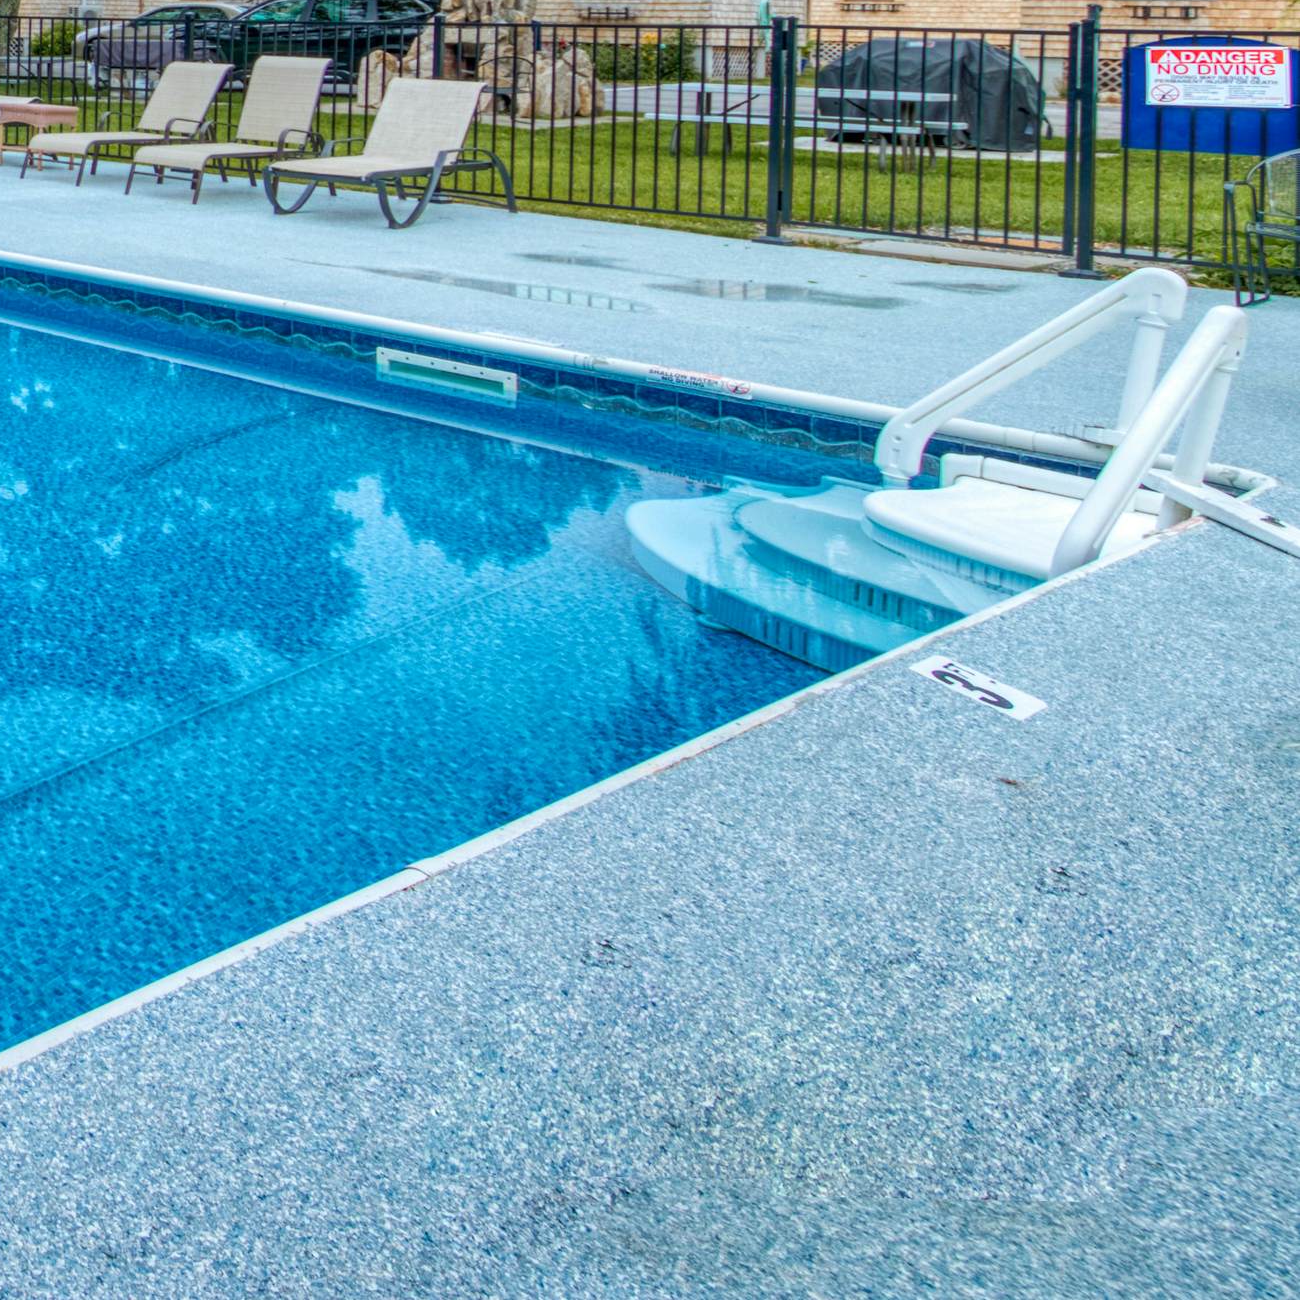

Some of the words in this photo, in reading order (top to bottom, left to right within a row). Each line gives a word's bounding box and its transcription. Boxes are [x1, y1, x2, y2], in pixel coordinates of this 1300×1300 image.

[1180, 51, 1277, 63] DANGER
[1157, 64, 1189, 75] NO
[1198, 64, 1277, 76] DIVING
[648, 369, 687, 380] SHALLOW
[676, 379, 705, 388] DIVING
[931, 670, 1014, 709] 3
